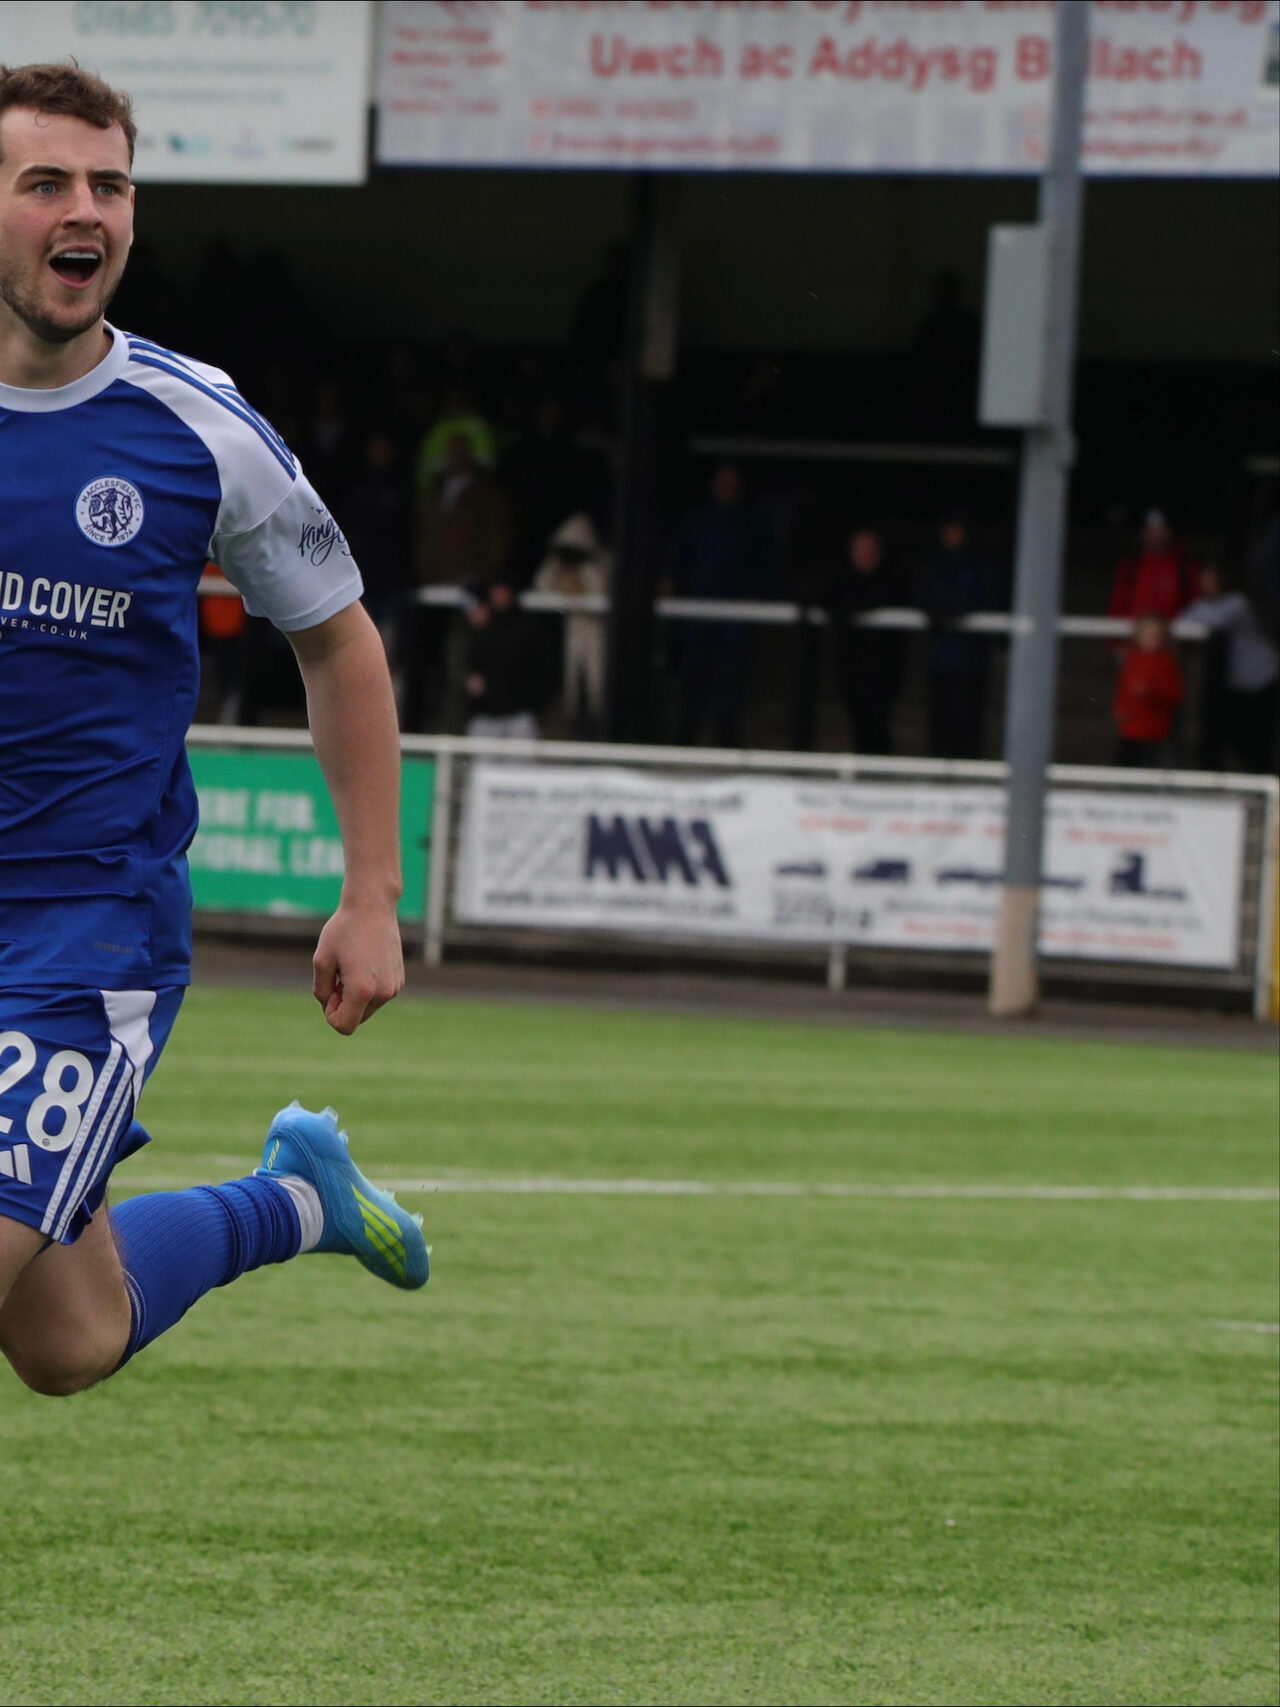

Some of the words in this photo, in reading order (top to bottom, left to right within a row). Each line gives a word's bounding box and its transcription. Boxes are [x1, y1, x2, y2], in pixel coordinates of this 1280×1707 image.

[590, 33, 724, 78] Uwch
[739, 44, 793, 79] ac
[810, 37, 997, 92] Addysg
[1015, 37, 1203, 82] Blach
[82, 480, 136, 503] MACCLESFIELD
[84, 524, 105, 542] SINCE
[117, 529, 133, 542] 1874
[28, 577, 132, 628] COVER
